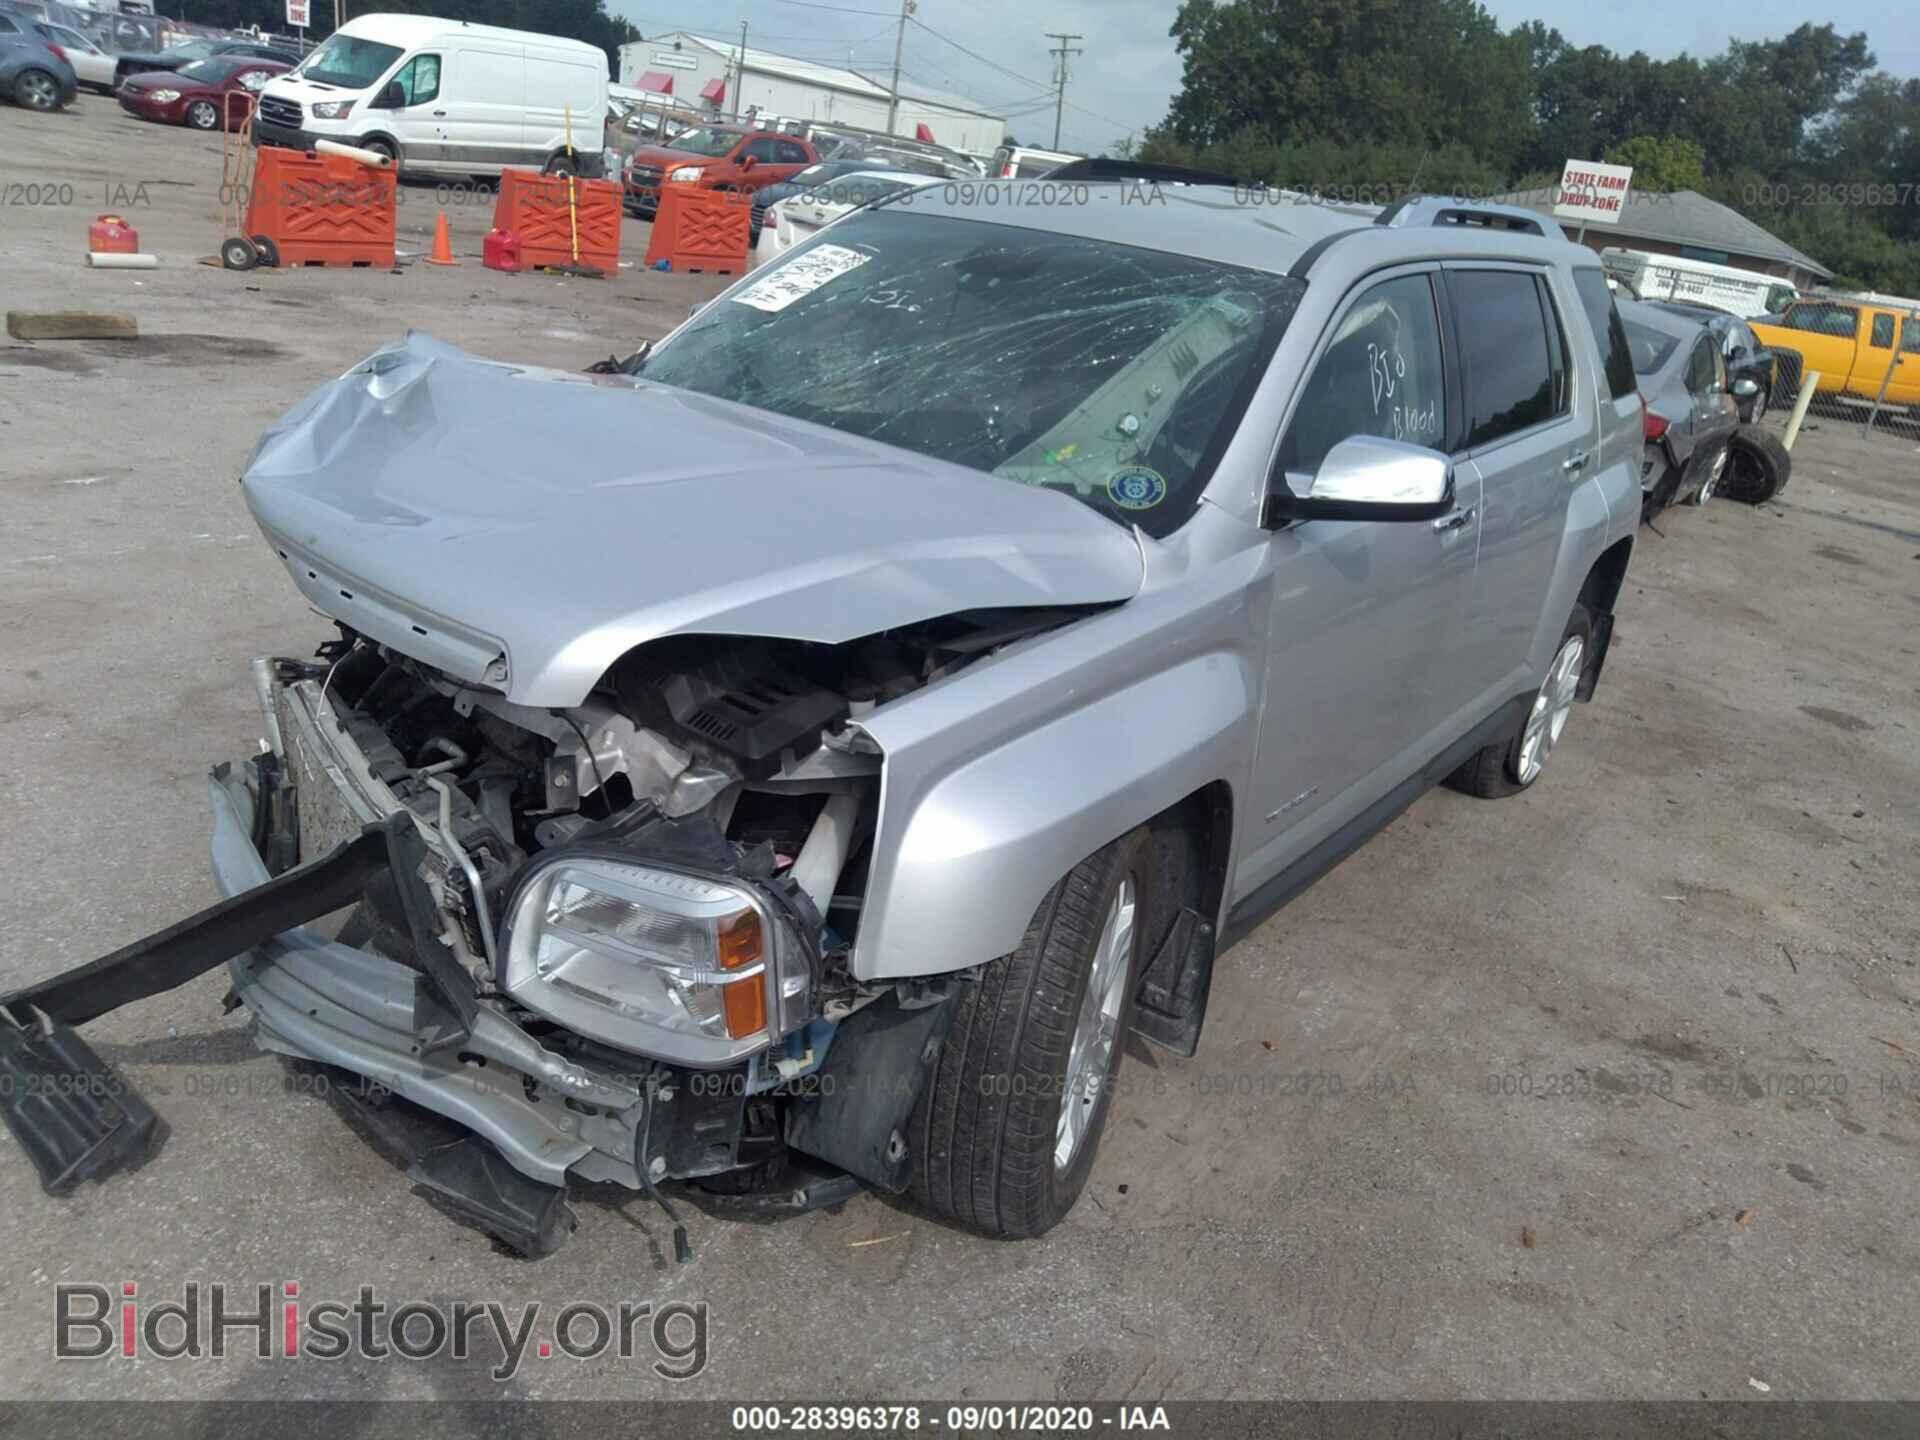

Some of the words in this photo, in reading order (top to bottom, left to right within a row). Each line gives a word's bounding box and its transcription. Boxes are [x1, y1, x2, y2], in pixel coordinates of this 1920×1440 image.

[1565, 171, 1596, 186] STATE
[1597, 176, 1627, 191] FARM
[1560, 191, 1591, 207] DROP
[1592, 196, 1620, 211] ZONE
